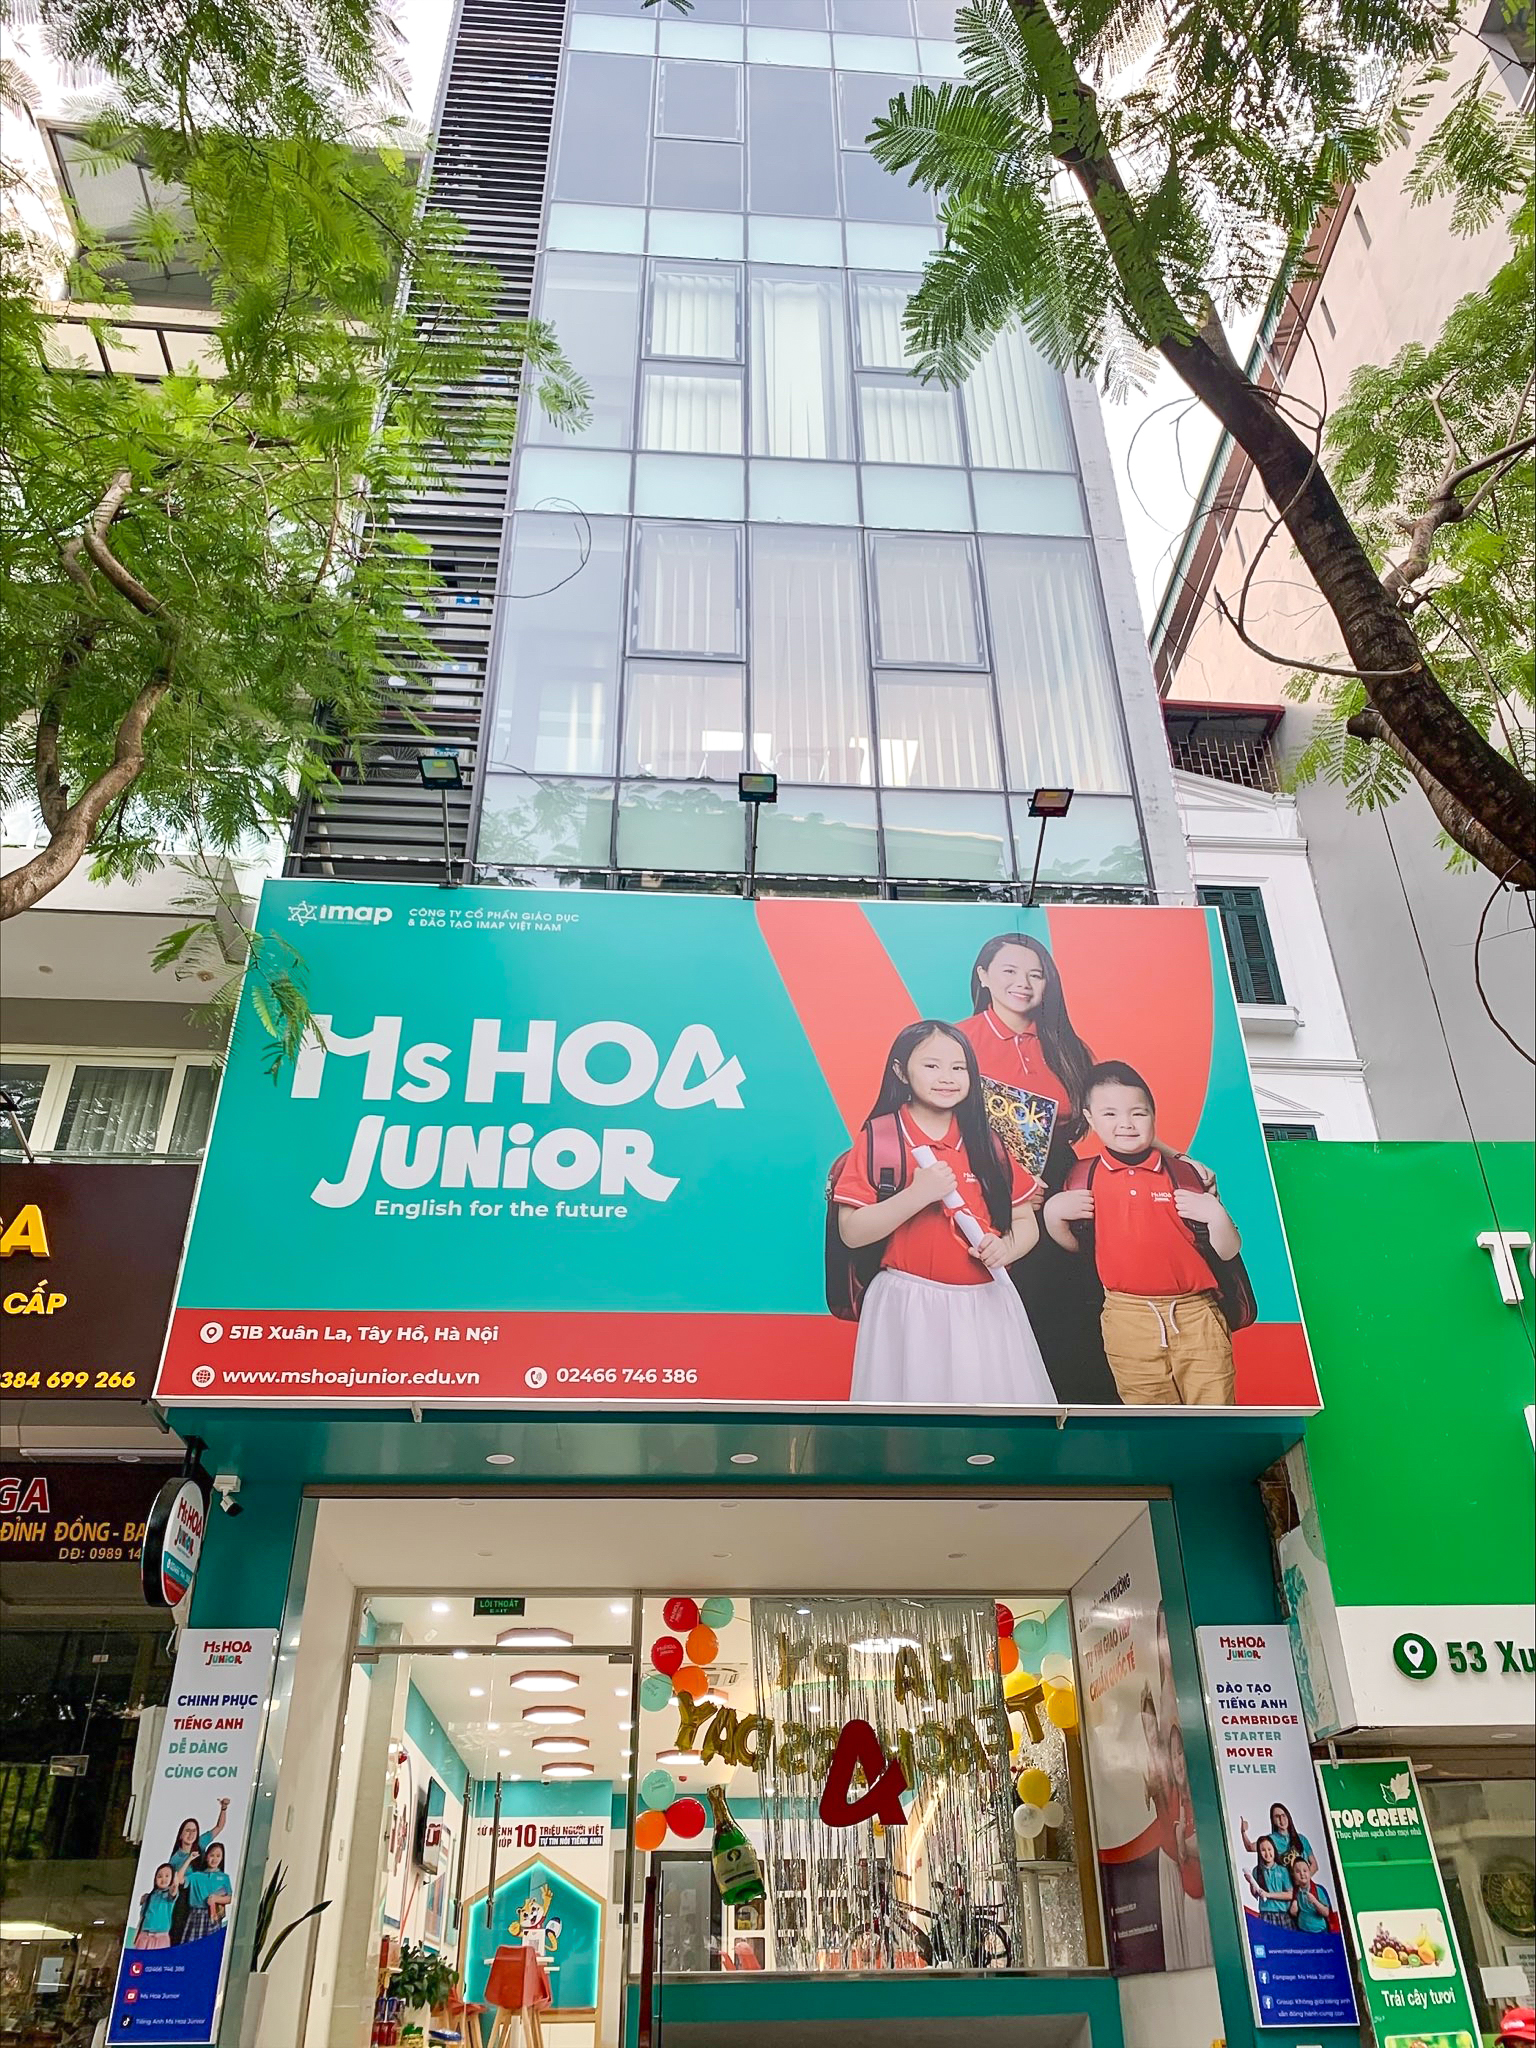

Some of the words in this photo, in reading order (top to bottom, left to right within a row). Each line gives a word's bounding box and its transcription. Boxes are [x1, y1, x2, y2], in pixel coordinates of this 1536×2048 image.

[320, 905, 393, 925] imap
[408, 908, 446, 918] CÔNG
[450, 910, 462, 919] TY
[521, 910, 553, 922] GIÁO
[555, 912, 580, 923] DỤC
[408, 918, 416, 927] &
[450, 919, 473, 930] TẠO
[476, 920, 506, 930] IMAP
[508, 921, 533, 932] VIỆT
[535, 923, 562, 932] NAM
[290, 1014, 452, 1103] Ms
[465, 1018, 747, 1110] HOA
[374, 1199, 462, 1220] English
[469, 1200, 503, 1217] for
[510, 1200, 549, 1217] the
[555, 1201, 628, 1218] future
[0, 1204, 50, 1258] A
[1476, 1231, 1535, 1305] T
[3, 1279, 68, 1314] CẤP
[229, 1325, 263, 1341] 51B
[267, 1325, 319, 1341] Xuân
[323, 1326, 353, 1343] La,
[358, 1326, 393, 1344] Tây
[396, 1324, 429, 1343] Hồ,
[434, 1326, 460, 1341] Hà
[465, 1325, 498, 1345] Nội
[0, 1371, 41, 1389] 384
[46, 1371, 90, 1389] 699
[94, 1371, 136, 1389] 266
[222, 1368, 480, 1387] www.mshoajunior.edu.vn
[556, 1367, 618, 1383] 02466
[621, 1368, 658, 1383] 746
[661, 1368, 698, 1384] 386
[0, 1477, 51, 1514] GA
[54, 1515, 111, 1542] ĐỒNG
[58, 1547, 86, 1560] DĐ:
[89, 1547, 123, 1560] 0989
[203, 1640, 221, 1653] Ms
[221, 1640, 253, 1654] HOA
[1219, 1636, 1237, 1649] Ms
[1236, 1636, 1266, 1649] HOA
[1446, 1640, 1488, 1674] 53
[1493, 1640, 1535, 1674] Xu
[1216, 1681, 1243, 1694] ĐÀO
[1246, 1683, 1272, 1696] TẠO
[177, 1694, 220, 1707] CHINH
[221, 1694, 259, 1710] PHỤC
[1218, 1696, 1257, 1709] TIẾNG
[1260, 1699, 1288, 1709] ANH
[173, 1714, 213, 1730] TIẾNG
[214, 1717, 244, 1730] ANH
[1221, 1715, 1299, 1725] CAMBRIDGE
[1224, 1731, 1282, 1741] STARTER
[168, 1737, 187, 1754] DỄ
[189, 1739, 229, 1754] DÀNG
[1226, 1747, 1274, 1758] MOVER
[164, 1763, 204, 1779] CÙNG
[207, 1766, 238, 1778] CON
[1229, 1764, 1277, 1774] FLYLER
[1330, 1809, 1365, 1829] TOP
[1366, 1807, 1420, 1828] GREEN
[514, 1823, 537, 1848] 10
[1385, 1828, 1397, 1837] cho
[1381, 1989, 1406, 2007] Trái
[1407, 1988, 1428, 2010] cây
[1429, 1987, 1456, 2004] tươi
